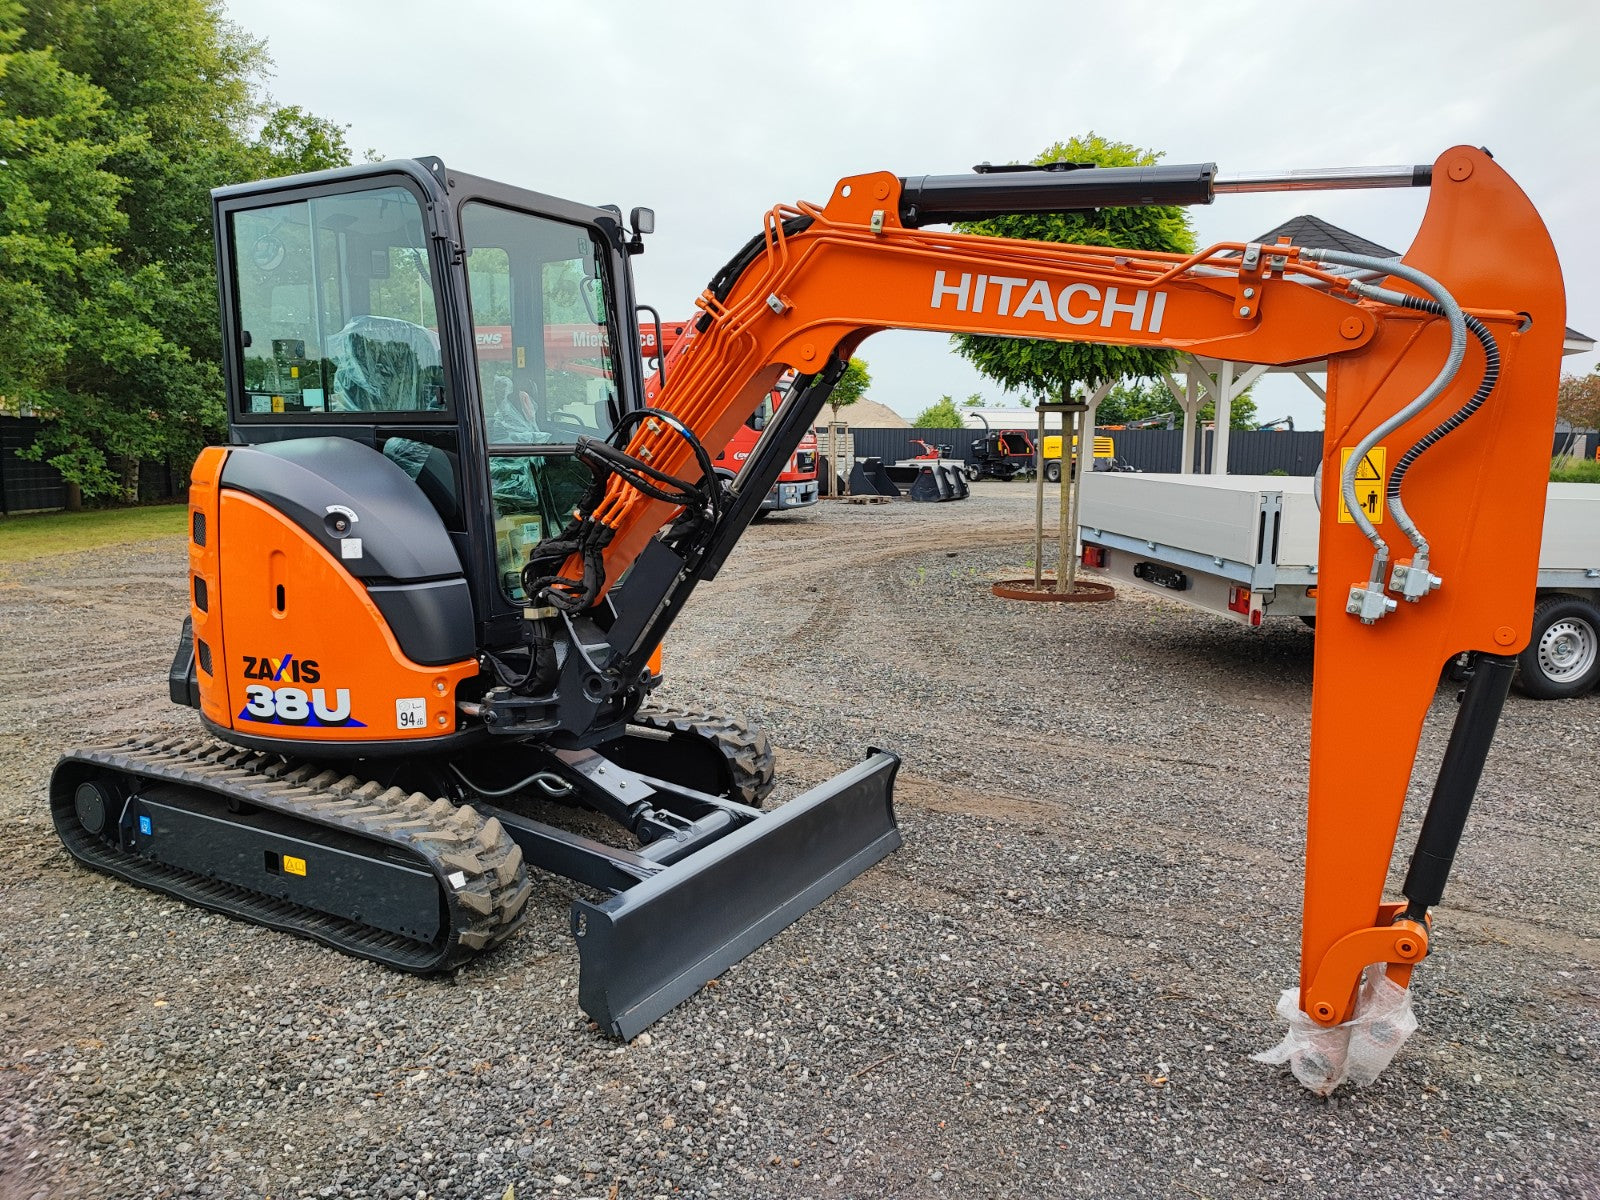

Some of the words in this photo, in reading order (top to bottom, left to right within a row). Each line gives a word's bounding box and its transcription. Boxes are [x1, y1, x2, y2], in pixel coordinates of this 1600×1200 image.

[930, 270, 1167, 333] HITACHI
[243, 654, 320, 683] ZAXIS
[245, 684, 351, 725] 38U
[401, 712, 415, 726] 94
